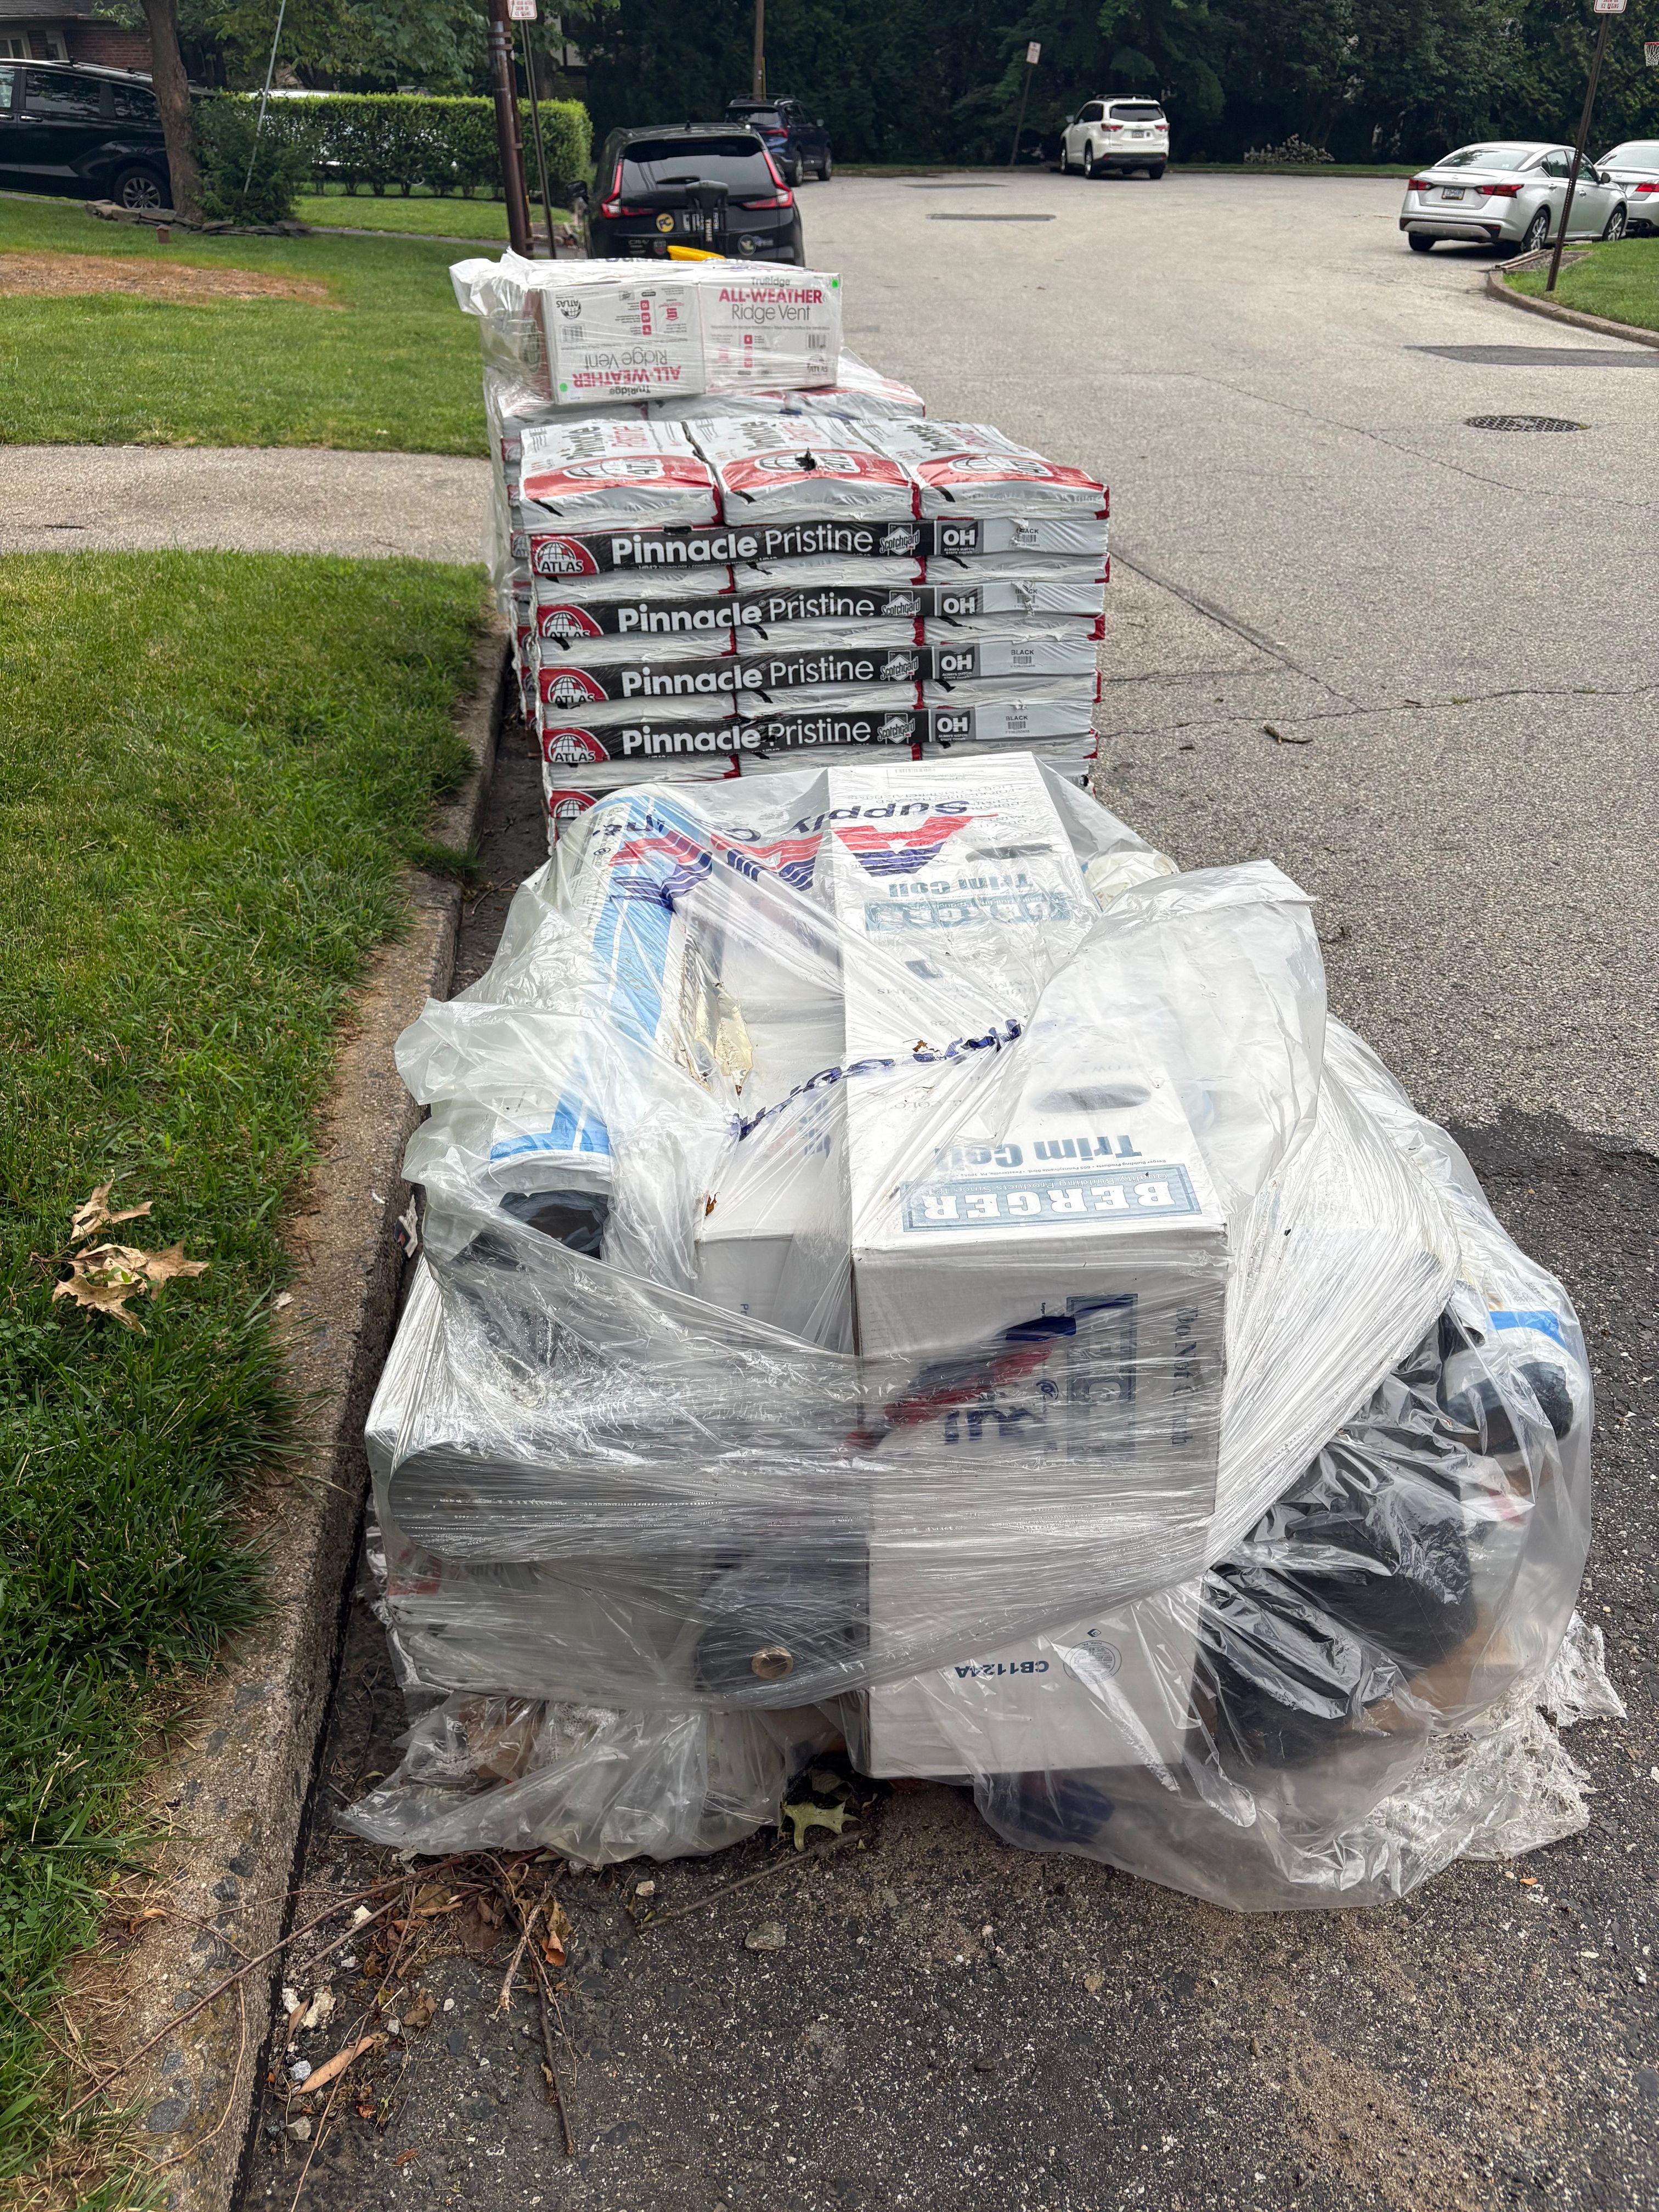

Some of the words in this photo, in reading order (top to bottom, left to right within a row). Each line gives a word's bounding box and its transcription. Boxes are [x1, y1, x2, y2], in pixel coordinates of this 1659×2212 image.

[751, 276, 791, 287] TruRidge
[556, 300, 579, 308] ATLAS
[719, 288, 823, 303] ALL-WEATHER
[731, 303, 775, 324] Ridge
[777, 304, 811, 320] Vent
[584, 354, 619, 370] Vent
[622, 347, 667, 367] Ridge
[572, 366, 681, 388] ALL-WEATHER
[608, 386, 651, 397] TruRidge
[765, 523, 873, 555] Pristine
[879, 529, 920, 554] Scotchgard
[943, 529, 975, 546] OH
[541, 561, 584, 572] ATLAS
[770, 592, 875, 622] Pristine
[881, 597, 921, 616] Scotchgard
[943, 597, 975, 614] OH
[770, 656, 874, 686] Pristine
[879, 656, 919, 680] Scotchgard
[941, 654, 972, 671] OH
[769, 718, 871, 746] Pristine
[877, 718, 916, 741] Scotchgard
[937, 717, 968, 732] OH
[555, 752, 595, 762] ATLAS
[788, 802, 968, 836] Supply
[888, 881, 951, 898] Coil
[958, 874, 1033, 891] Trim
[1034, 1135, 1142, 1161] Trim
[1059, 1177, 1115, 1187] Building
[1119, 1172, 1168, 1183] Quality
[954, 1186, 992, 1194] Since
[996, 1182, 1055, 1193] Products
[923, 1181, 1175, 1220] BERGER
[1172, 1342, 1197, 1379] Not
[953, 1660, 1049, 1679] CB1124A
